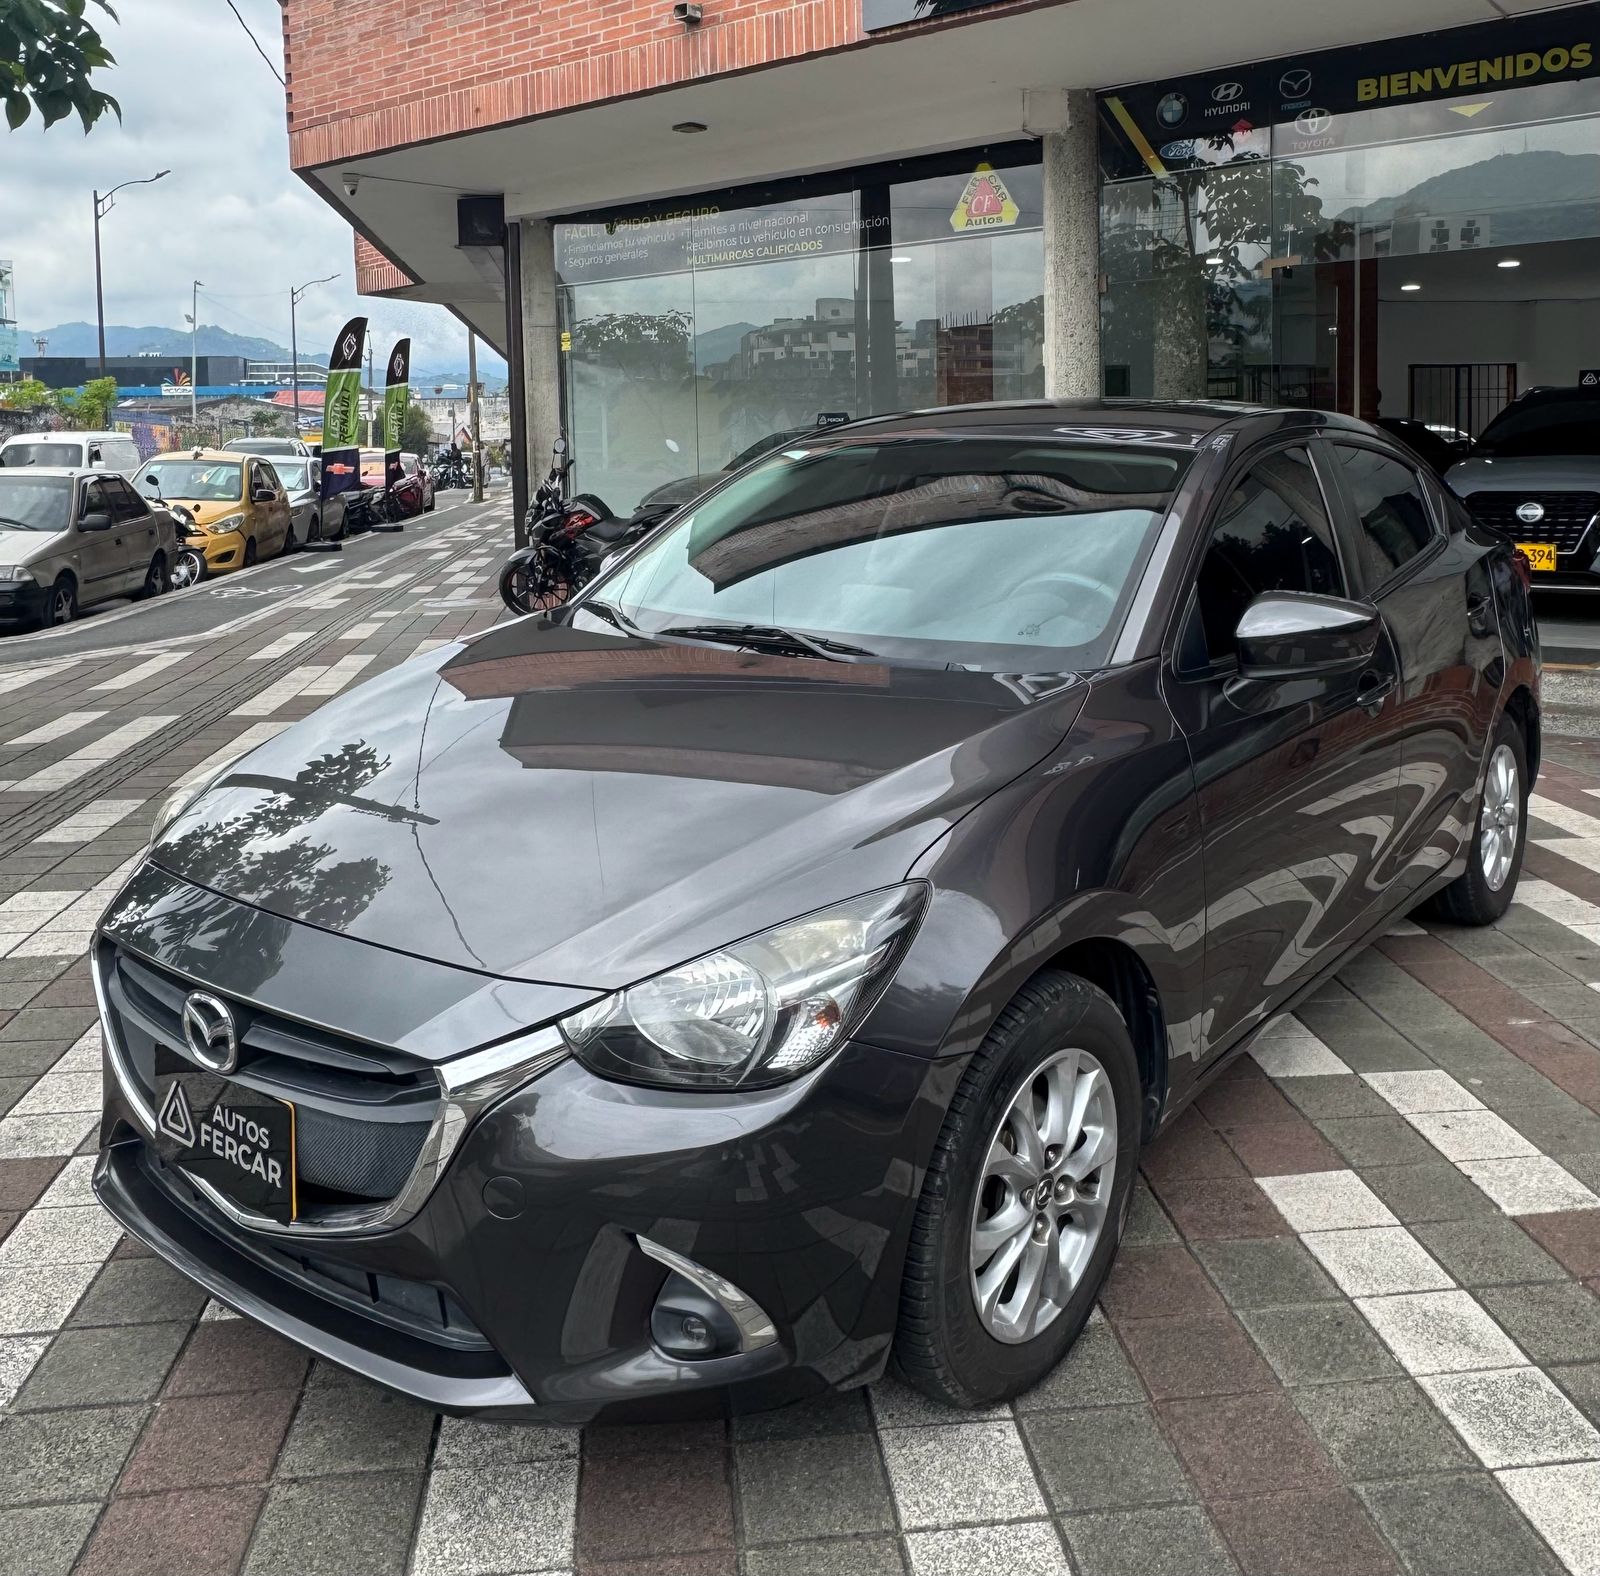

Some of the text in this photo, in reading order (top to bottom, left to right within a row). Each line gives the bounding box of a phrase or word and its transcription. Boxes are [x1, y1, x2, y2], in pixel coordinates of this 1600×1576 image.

[1357, 43, 1593, 101] BIENVENIDOS
[1204, 101, 1251, 117] HYUNDAI
[1292, 137, 1335, 151] TOYOTA
[654, 214, 663, 227] Y
[665, 206, 721, 224] SEGURO
[728, 224, 736, 234] a
[738, 218, 763, 232] nivel
[764, 211, 810, 230] nacional
[965, 216, 1003, 227] Autos
[686, 233, 737, 251] Recibimos
[739, 232, 750, 246] tu
[798, 224, 813, 237] en
[815, 215, 890, 237] consignación
[569, 249, 649, 268] Seguros generales
[686, 239, 824, 266] MULTIMARCAS CALIFICADOS
[339, 387, 352, 445] RENAULT
[212, 1104, 269, 1149] AUTOS
[201, 1122, 282, 1189] FERCAR
